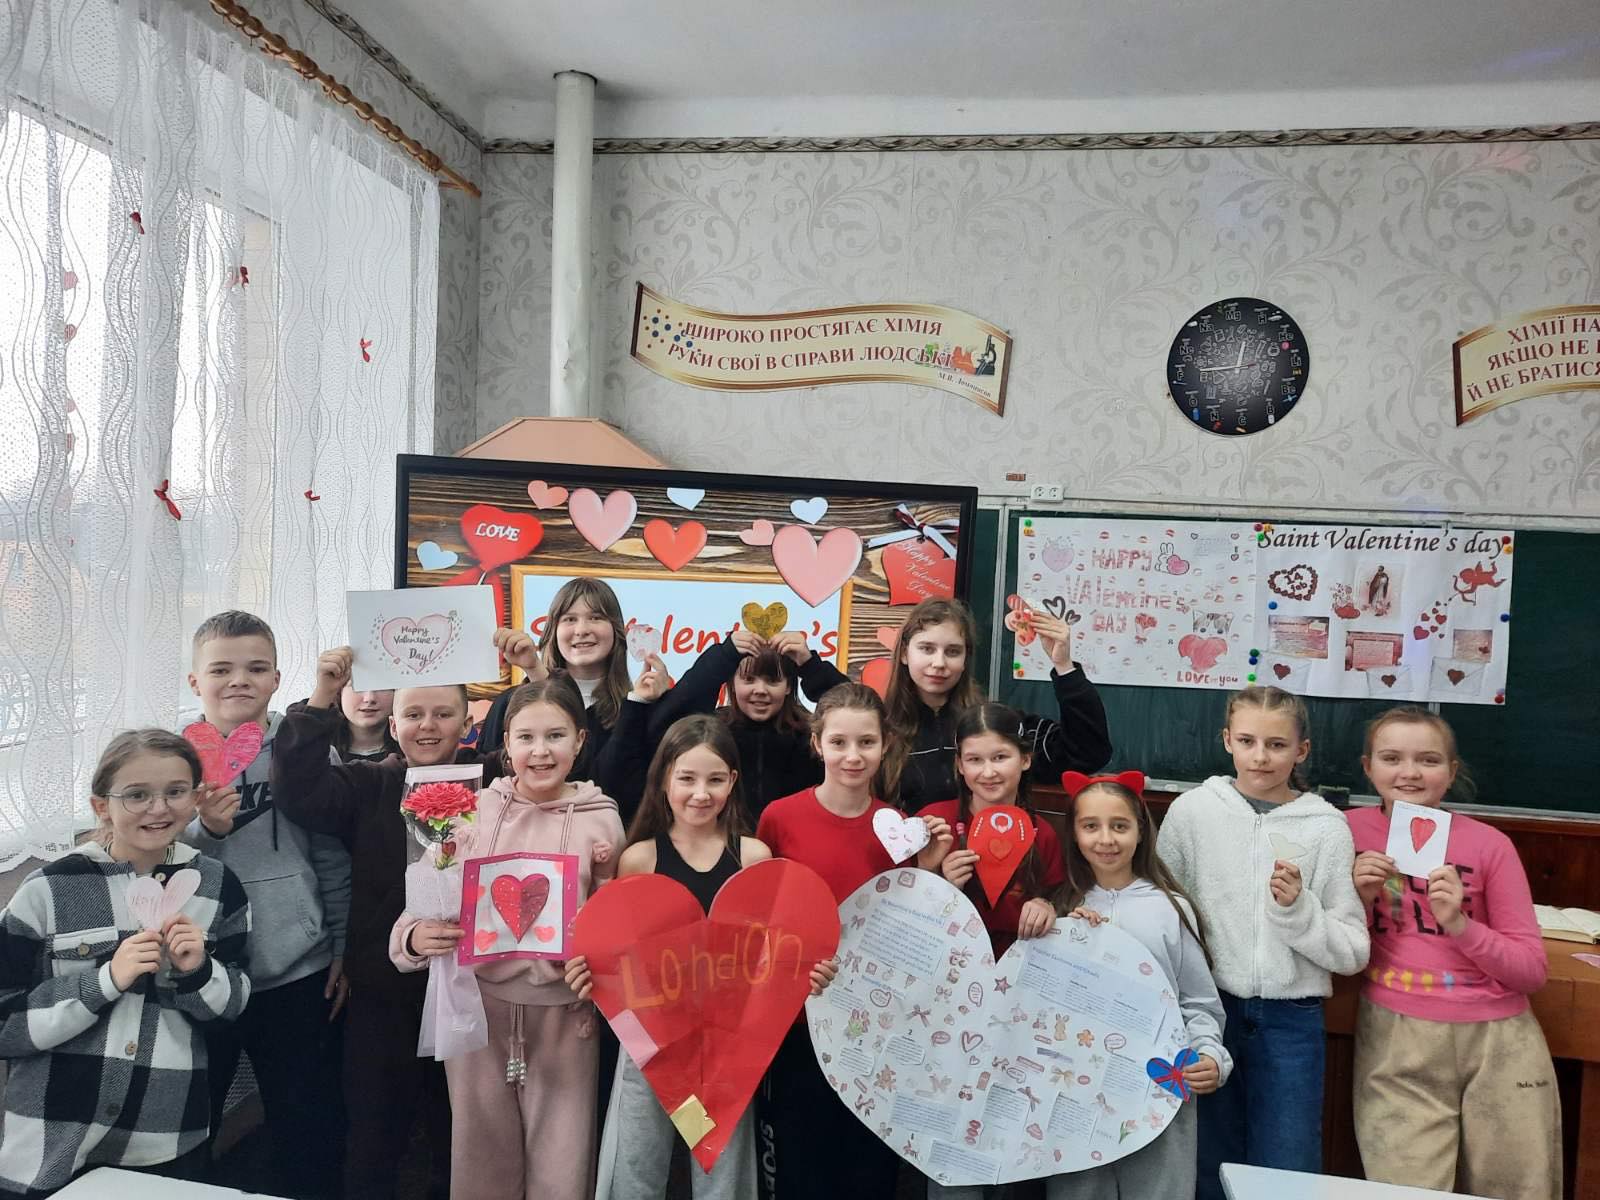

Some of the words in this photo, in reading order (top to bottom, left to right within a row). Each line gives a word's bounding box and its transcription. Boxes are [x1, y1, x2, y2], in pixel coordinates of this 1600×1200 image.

[685, 322, 765, 343] ШИРОКО
[770, 319, 882, 343] ПРОСТЯГАЄ
[884, 318, 942, 336] ХІМІЯ
[1507, 315, 1565, 345] ХІМІЇ
[667, 343, 713, 368] РУКИ
[717, 353, 761, 371] СВОЇ
[766, 356, 777, 370] В
[781, 349, 854, 368] СПРАВИ
[1488, 342, 1554, 371] ЯКЩО
[1561, 340, 1590, 356] НЕ
[1467, 383, 1483, 402] Й
[1486, 373, 1515, 394] НЕ
[475, 522, 521, 542] LOVE
[1257, 527, 1320, 550] Saint
[1324, 529, 1459, 552] Valentine's
[1464, 530, 1505, 559] day
[401, 625, 430, 637] Happy
[408, 648, 435, 667] Day!
